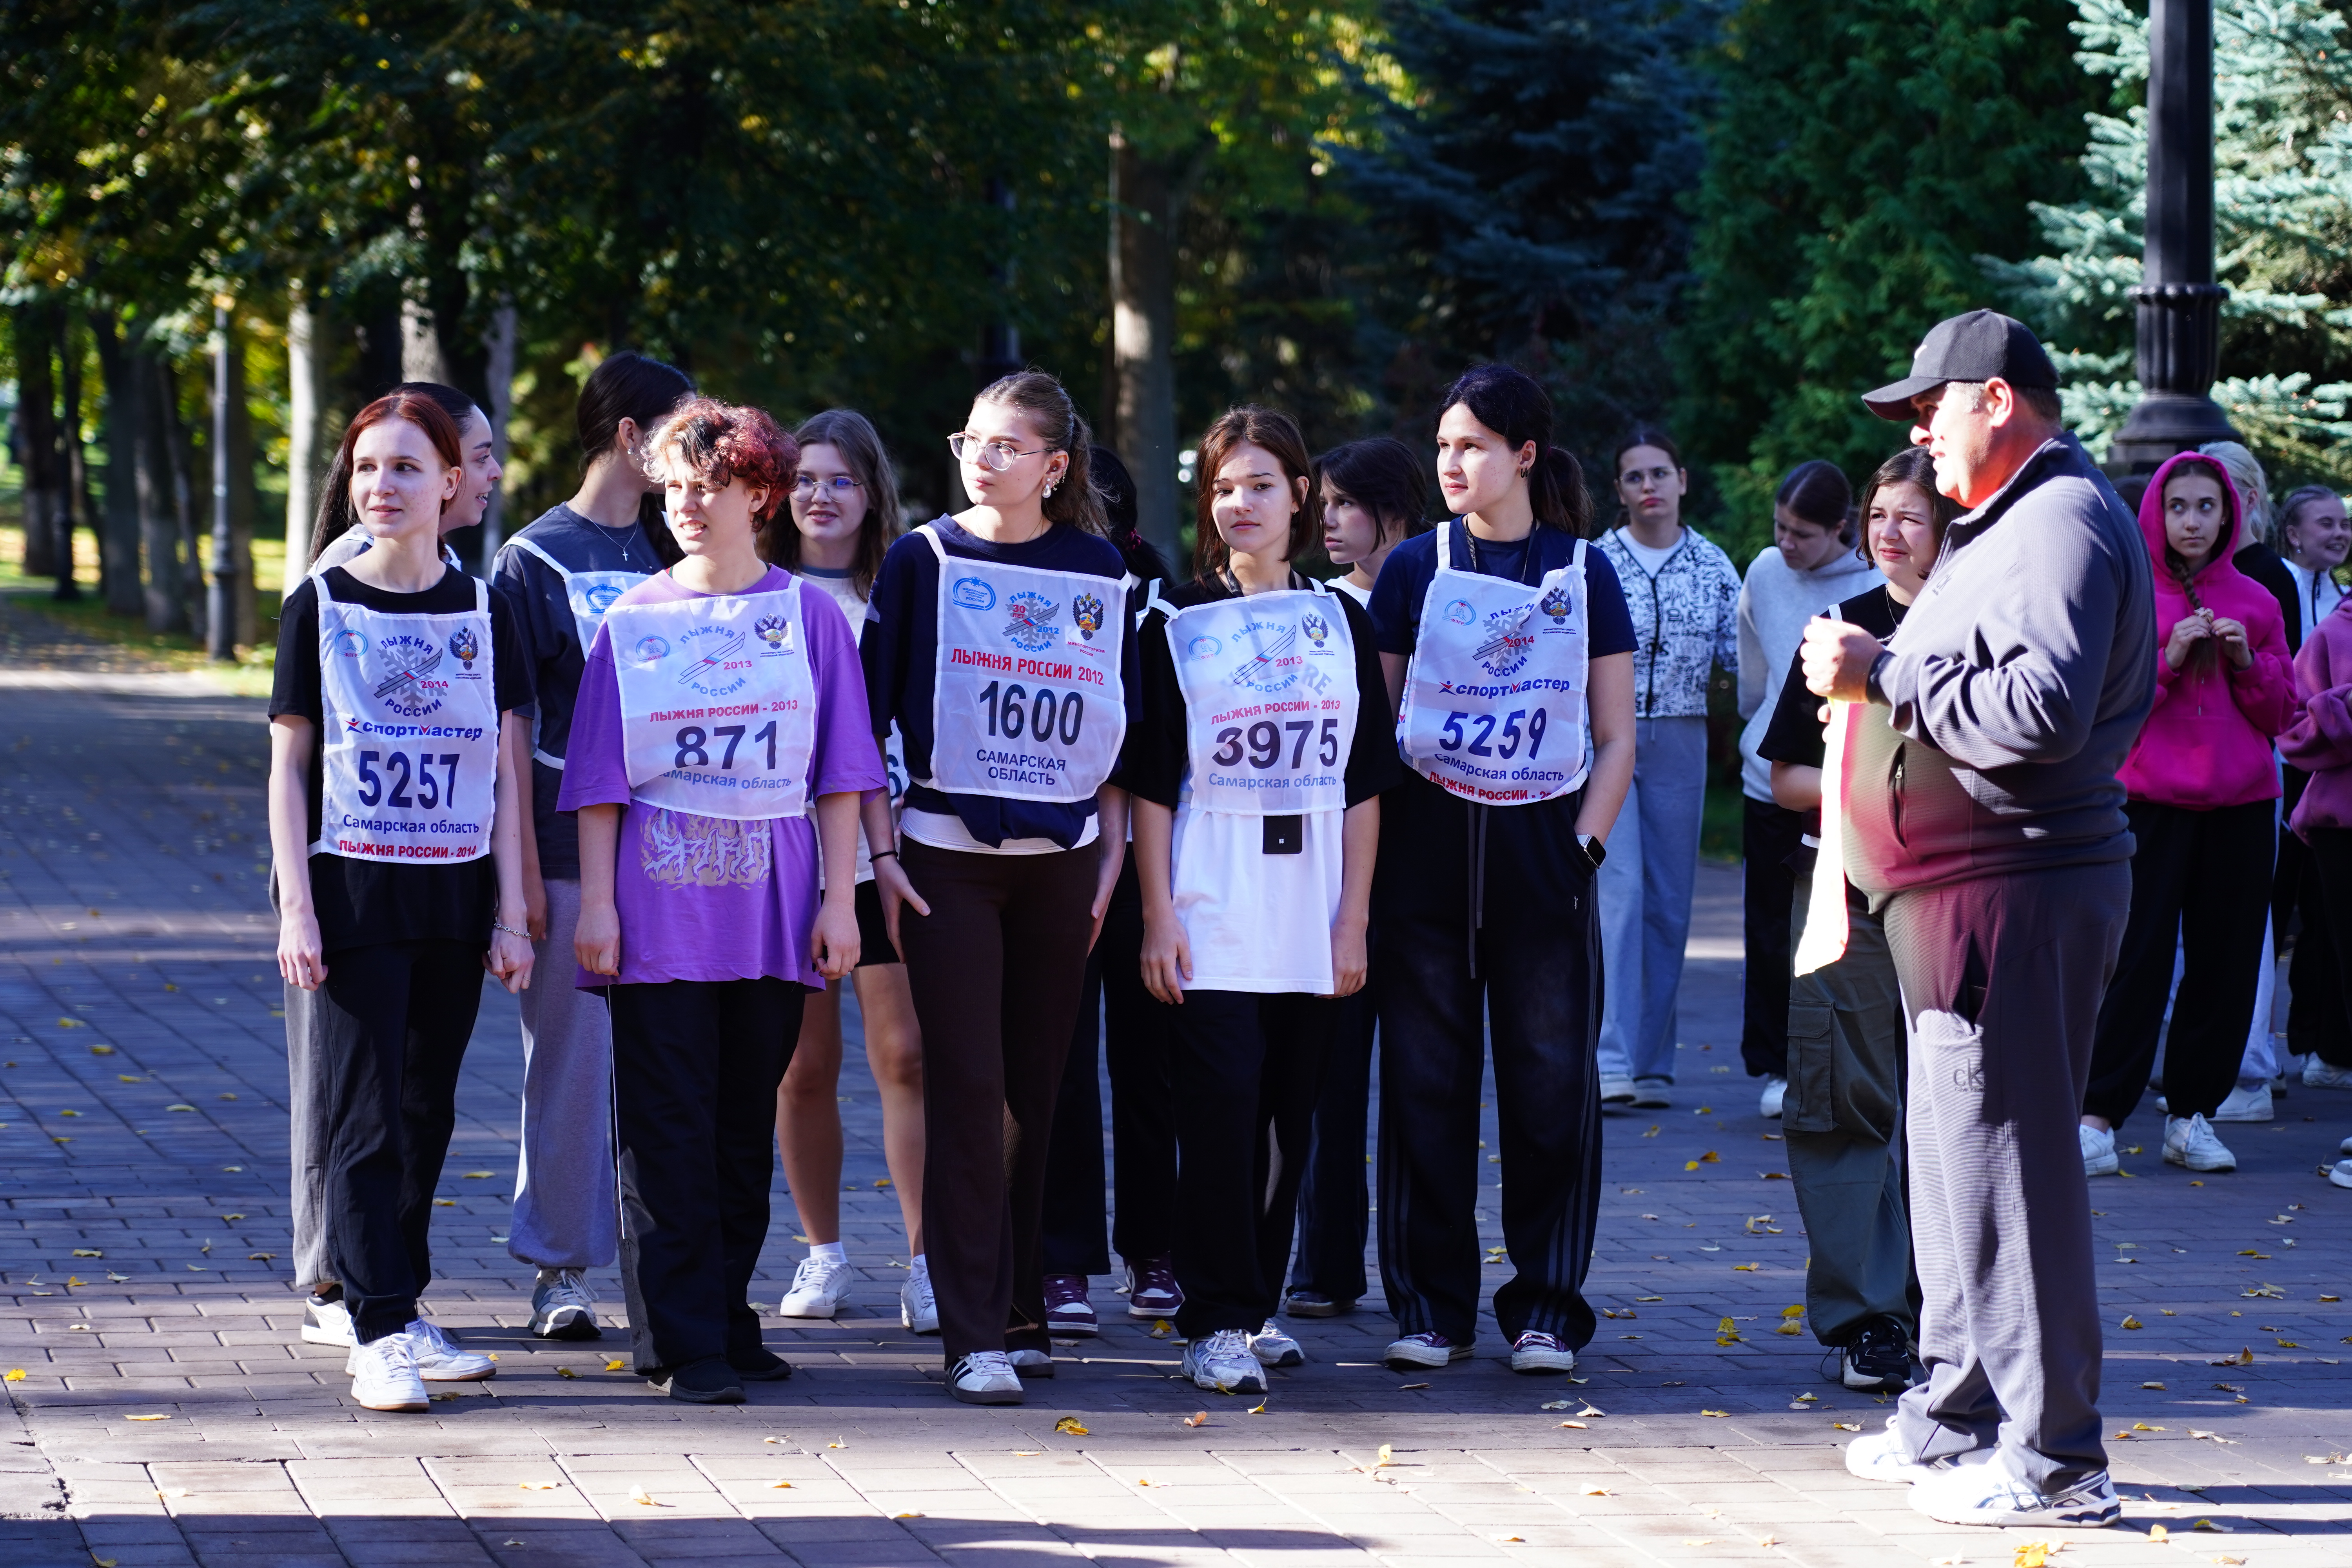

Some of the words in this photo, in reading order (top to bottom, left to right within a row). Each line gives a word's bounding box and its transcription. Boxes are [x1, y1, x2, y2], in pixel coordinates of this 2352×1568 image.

[1009, 592, 1052, 607] ЛЫЖНЯ
[1013, 604, 1025, 613] 30
[679, 626, 735, 644] ЛЫЖНЯ
[1230, 621, 1286, 643] ЛЫЖНЯ
[1508, 635, 1534, 648] 2014
[381, 635, 434, 655] ЛЫЖНЯ
[1011, 637, 1052, 652] РОССИИ
[1067, 641, 1105, 653] МИНСПОРТТУРИЗМ
[723, 660, 752, 670] 2013
[951, 648, 1012, 671] ЛЫЖНЯ
[1017, 658, 1072, 679] РОССИИ
[1078, 666, 1104, 686] 2012
[1276, 656, 1303, 667] 2013
[1482, 656, 1528, 677] РОССИИ
[420, 680, 449, 689] 2014
[690, 677, 746, 697] РОССИИ
[1246, 674, 1298, 693] РОССИИ
[384, 698, 443, 717] РОССИИ
[650, 708, 704, 722] ЛЫЖНЯ
[708, 703, 759, 717] РОССИИ
[771, 700, 798, 712] 2013
[980, 681, 1083, 746] 1600
[1211, 705, 1261, 725] ЛЫЖНЯ
[1264, 701, 1310, 714] РОССИИ
[1321, 700, 1341, 710] 2013
[1439, 707, 1546, 760] 5259
[675, 720, 777, 770] 871
[1212, 719, 1338, 769] 3975
[976, 749, 1066, 771] САМАРСКАЯ
[358, 750, 461, 810] 5257
[659, 769, 737, 788] амарская
[741, 777, 791, 789] область
[988, 767, 1055, 785] ОБЛАСТЬ
[1209, 773, 1290, 790] Самарская
[1294, 774, 1336, 788] область
[1512, 767, 1564, 781] область
[1429, 771, 1475, 797] ЛЫЖНЯ
[1478, 788, 1528, 801] РОССИИ
[343, 814, 426, 834] Самарская
[431, 819, 479, 835] область
[338, 840, 394, 857] ЛЫЖНЯ
[398, 842, 448, 858] РОССИИ
[457, 845, 477, 858] 2014
[1953, 1058, 1985, 1087] ck
